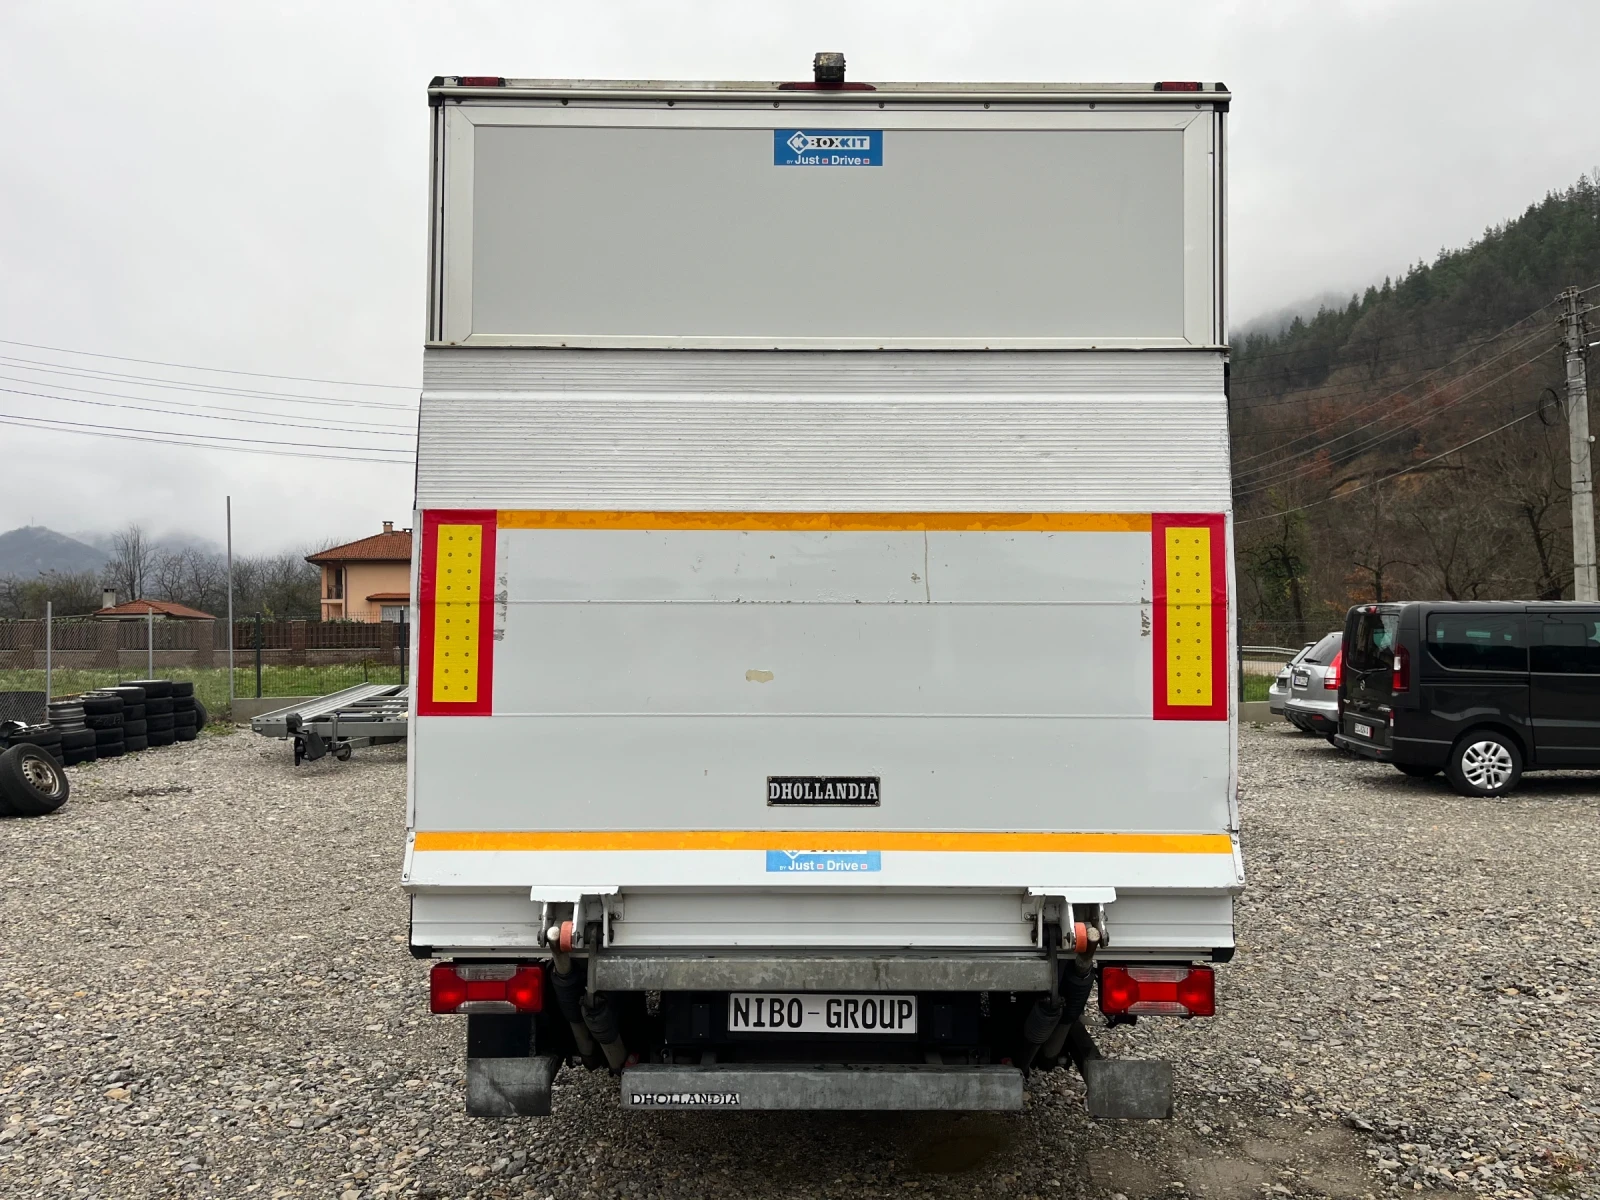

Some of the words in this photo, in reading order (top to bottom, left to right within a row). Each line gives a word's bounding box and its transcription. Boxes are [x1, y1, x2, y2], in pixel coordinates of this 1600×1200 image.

[810, 137, 867, 148] BOXKIT
[794, 155, 820, 165] Just
[831, 155, 861, 165] Drive
[769, 782, 878, 800] DHOLLANDIA
[788, 860, 814, 871] Just
[827, 860, 858, 871] Drive
[630, 1093, 740, 1105] DHOLLANDIA
